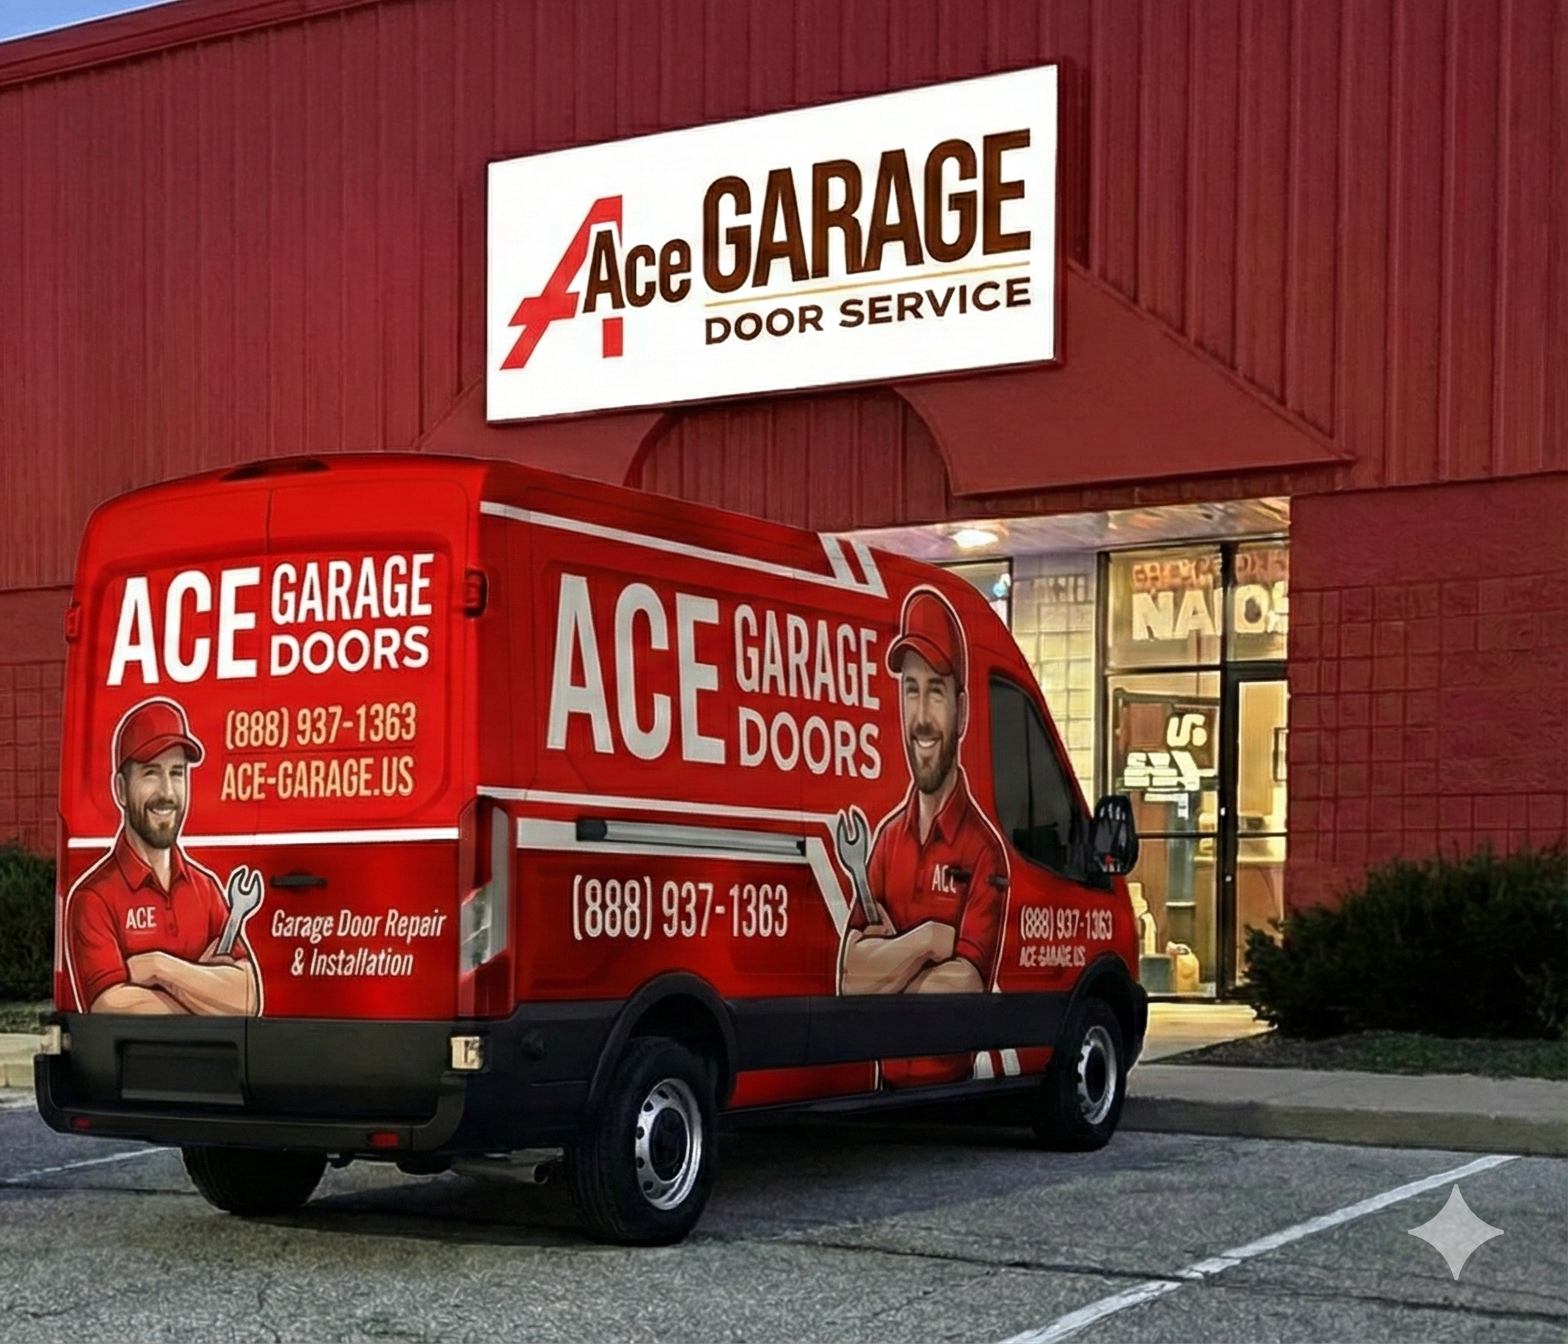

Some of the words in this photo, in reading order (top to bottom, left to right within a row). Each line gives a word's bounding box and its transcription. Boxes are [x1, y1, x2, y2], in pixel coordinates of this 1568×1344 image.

[581, 229, 692, 314] Ace
[702, 127, 1032, 294] GARAGE
[705, 304, 824, 346] DOOR
[838, 277, 1032, 329] SERVICE
[106, 566, 261, 686] ACE
[270, 553, 434, 625] GARAGE
[269, 625, 430, 677] DOORS
[546, 573, 726, 765] ACE
[734, 604, 880, 711] GARAGE
[225, 707, 289, 750] (888)
[296, 701, 417, 746] 937-1363
[738, 705, 882, 780] DOORS
[220, 755, 414, 801] ACE-GARAGE.US
[125, 906, 157, 929] ACE
[271, 909, 334, 944] Garage
[336, 909, 383, 937] Door
[384, 908, 447, 944] Repair
[573, 874, 652, 941] (888)
[662, 880, 788, 938] 937-1363
[1020, 905, 1054, 942] (888)
[1056, 908, 1113, 941] 937-1363
[291, 947, 305, 976] &
[309, 947, 414, 976] Installation
